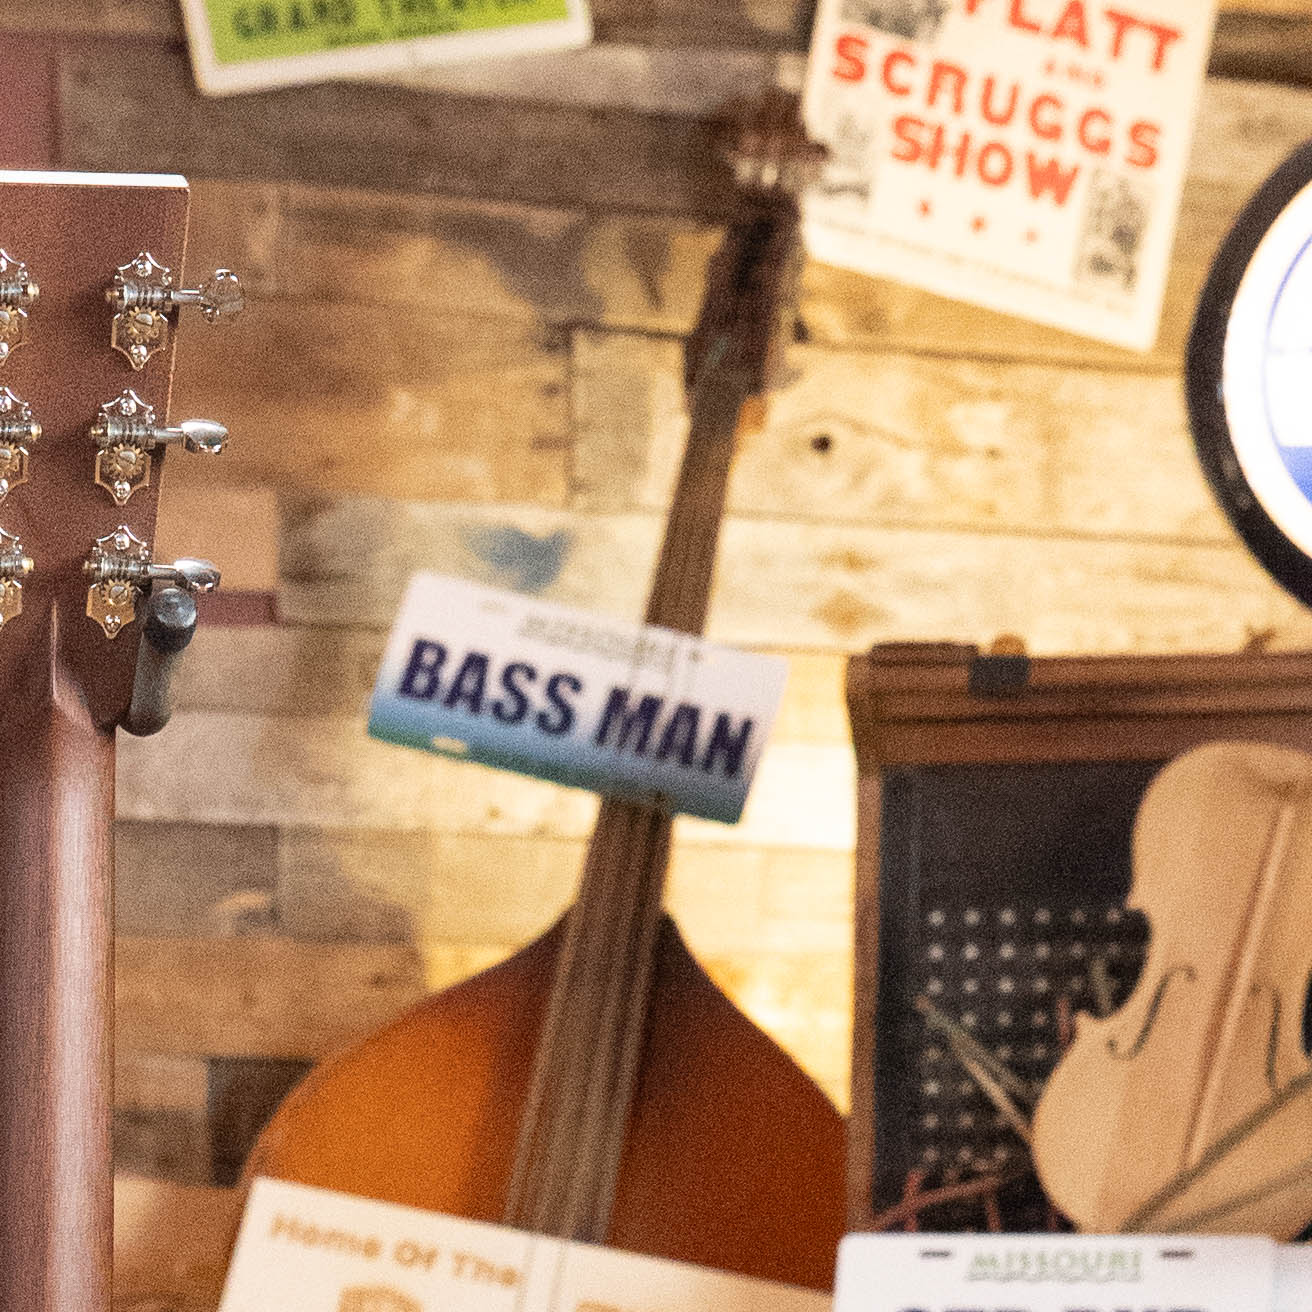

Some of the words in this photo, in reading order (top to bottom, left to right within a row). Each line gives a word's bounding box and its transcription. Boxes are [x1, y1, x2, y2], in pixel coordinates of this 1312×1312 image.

[963, 0, 1184, 73] LATT
[831, 33, 1162, 171] SCRUGGS
[890, 115, 1080, 206] SHOW
[399, 638, 583, 736] BASS
[595, 684, 754, 778] MAN
